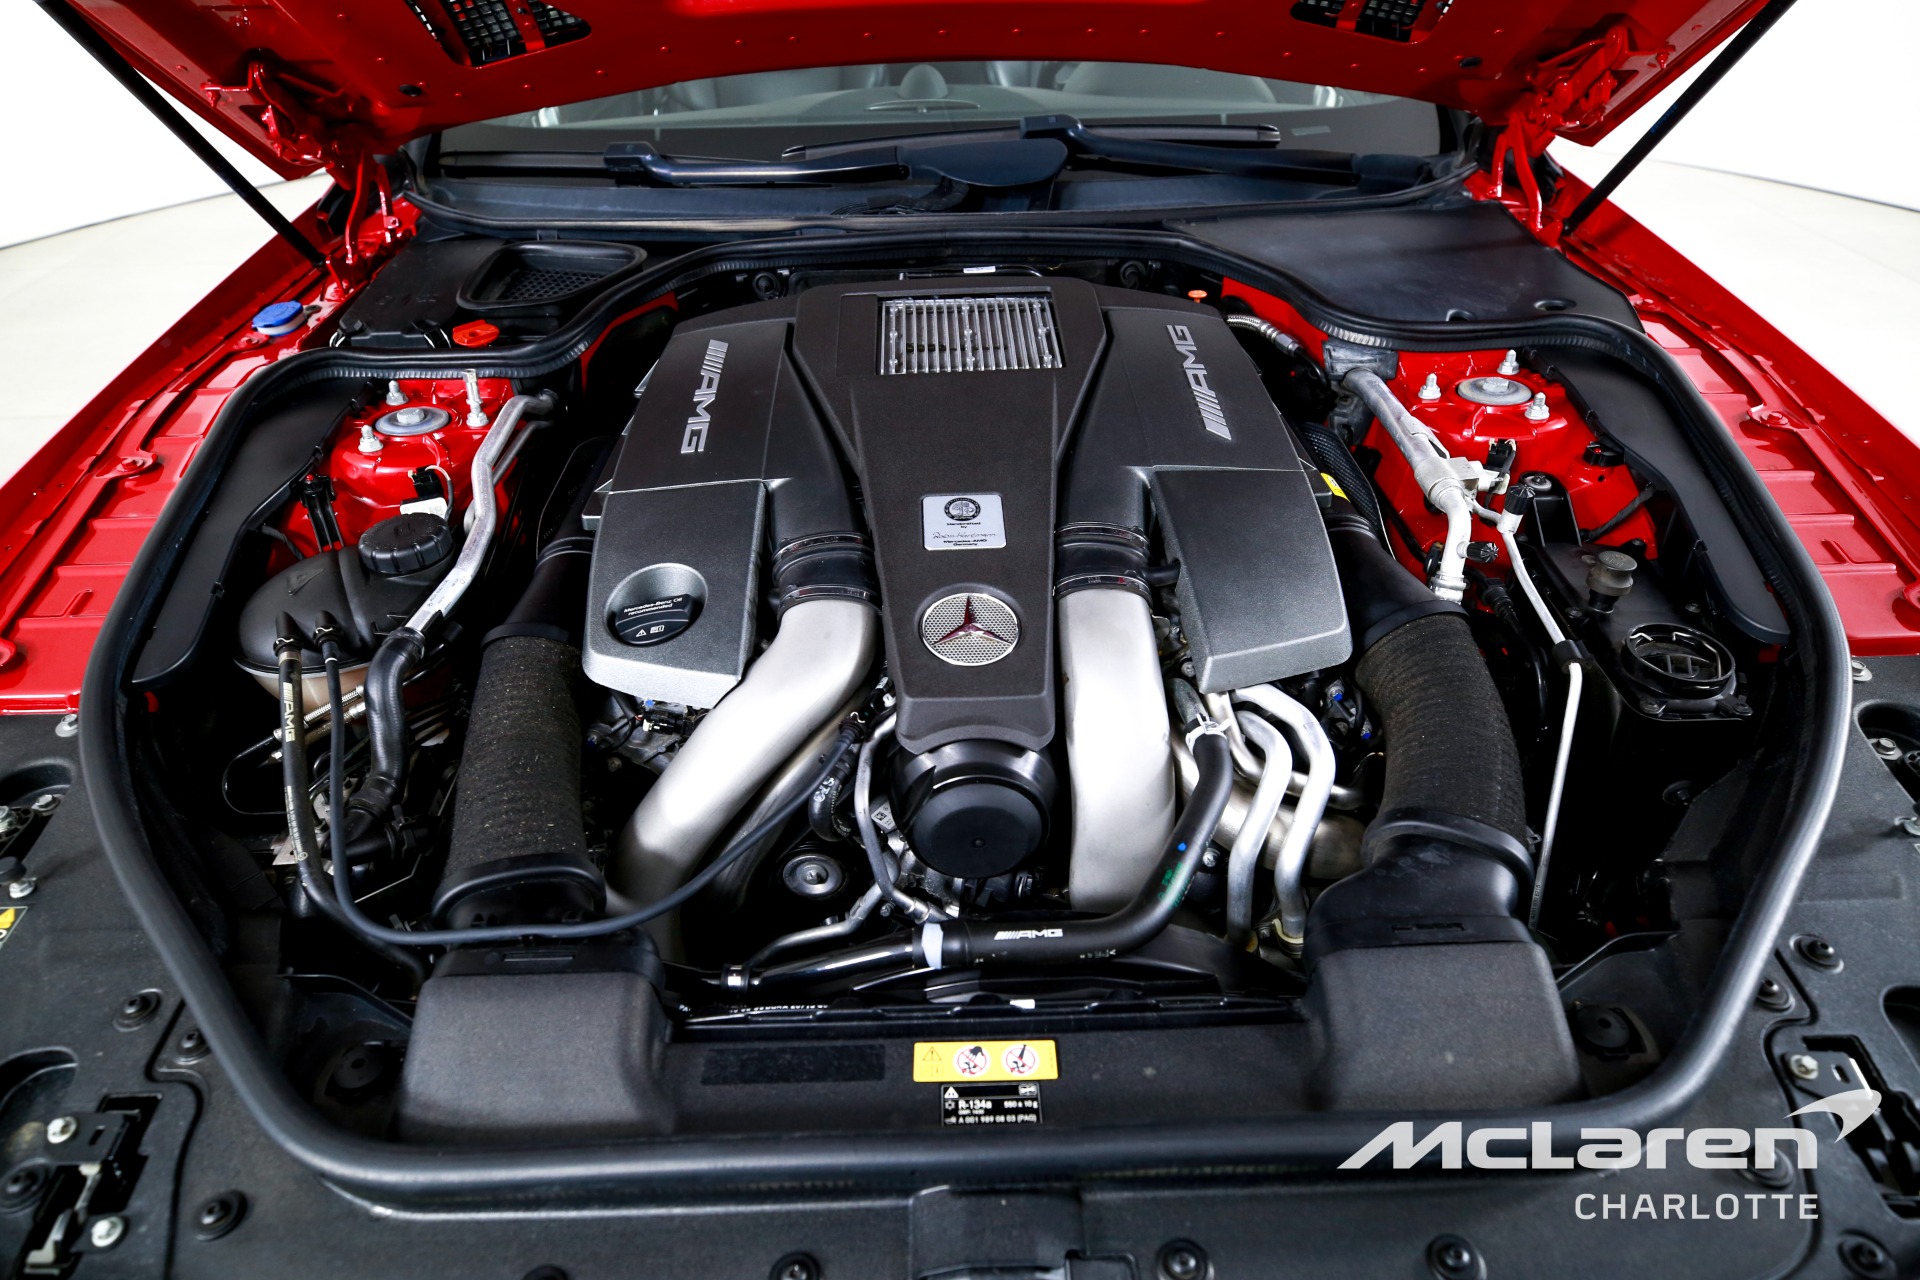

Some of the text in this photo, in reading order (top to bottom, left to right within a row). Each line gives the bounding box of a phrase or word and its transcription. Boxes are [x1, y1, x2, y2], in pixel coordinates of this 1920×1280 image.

[624, 599, 673, 613] Mercedes-Benz
[628, 603, 674, 616] recommended
[958, 1099, 993, 1110] R-134a
[958, 1115, 964, 1124] A
